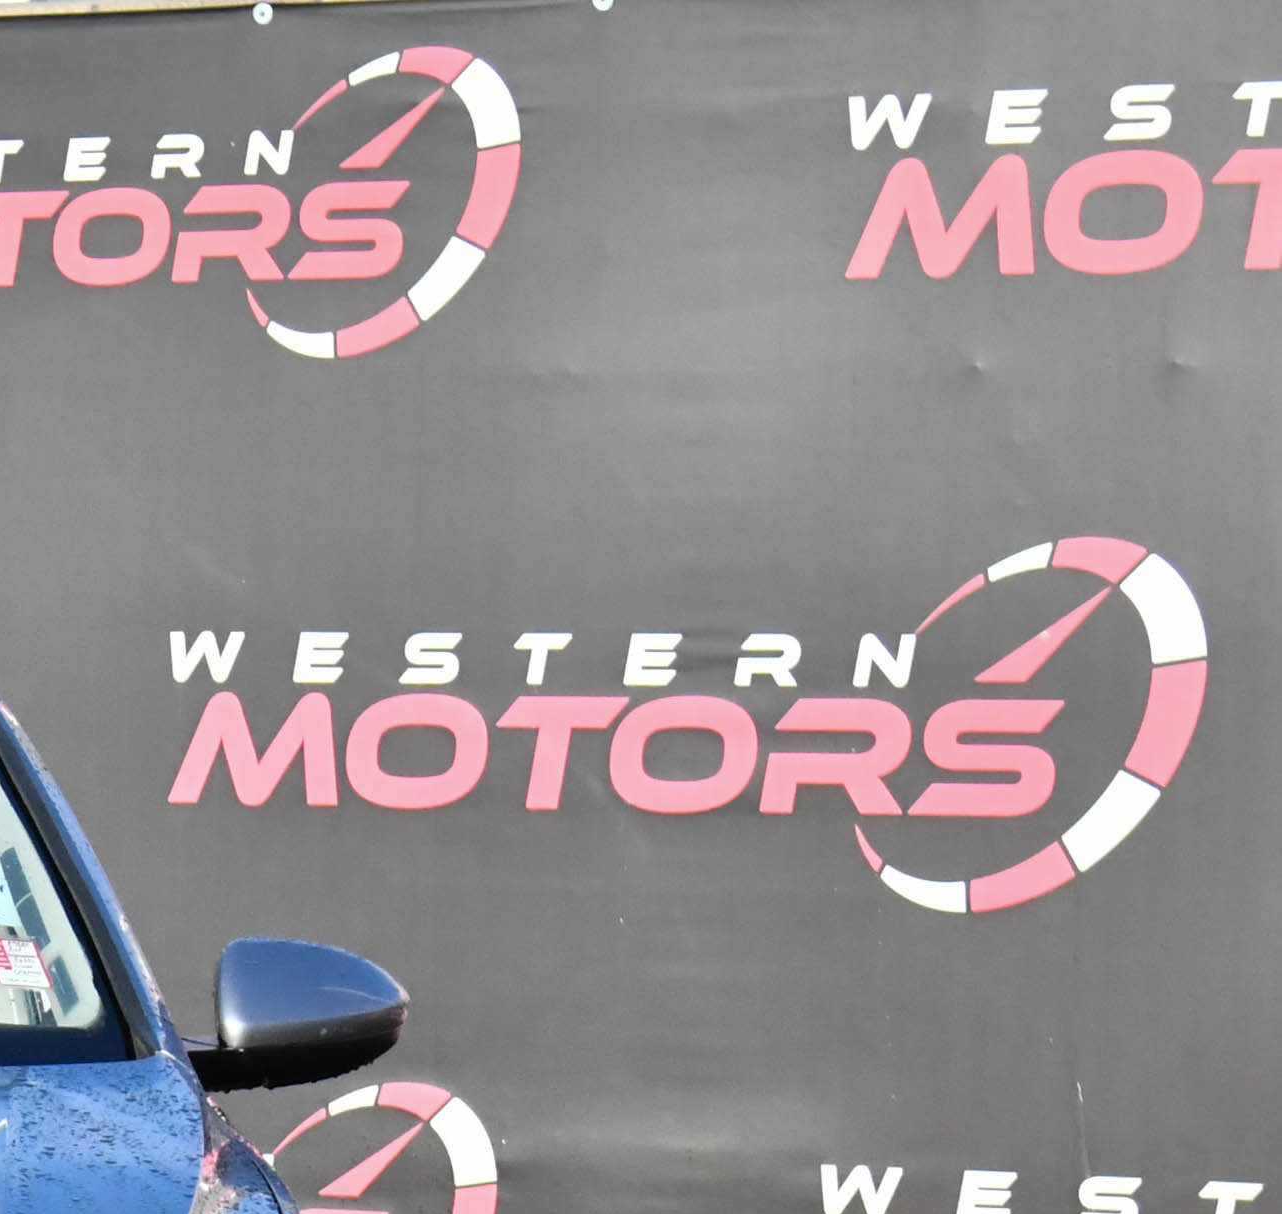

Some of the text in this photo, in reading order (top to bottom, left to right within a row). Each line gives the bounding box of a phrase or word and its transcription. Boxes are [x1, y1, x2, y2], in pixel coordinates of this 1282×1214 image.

[848, 80, 1282, 151] WEST
[169, 630, 917, 689] WESTERN
[167, 690, 1066, 818] MOTORS
